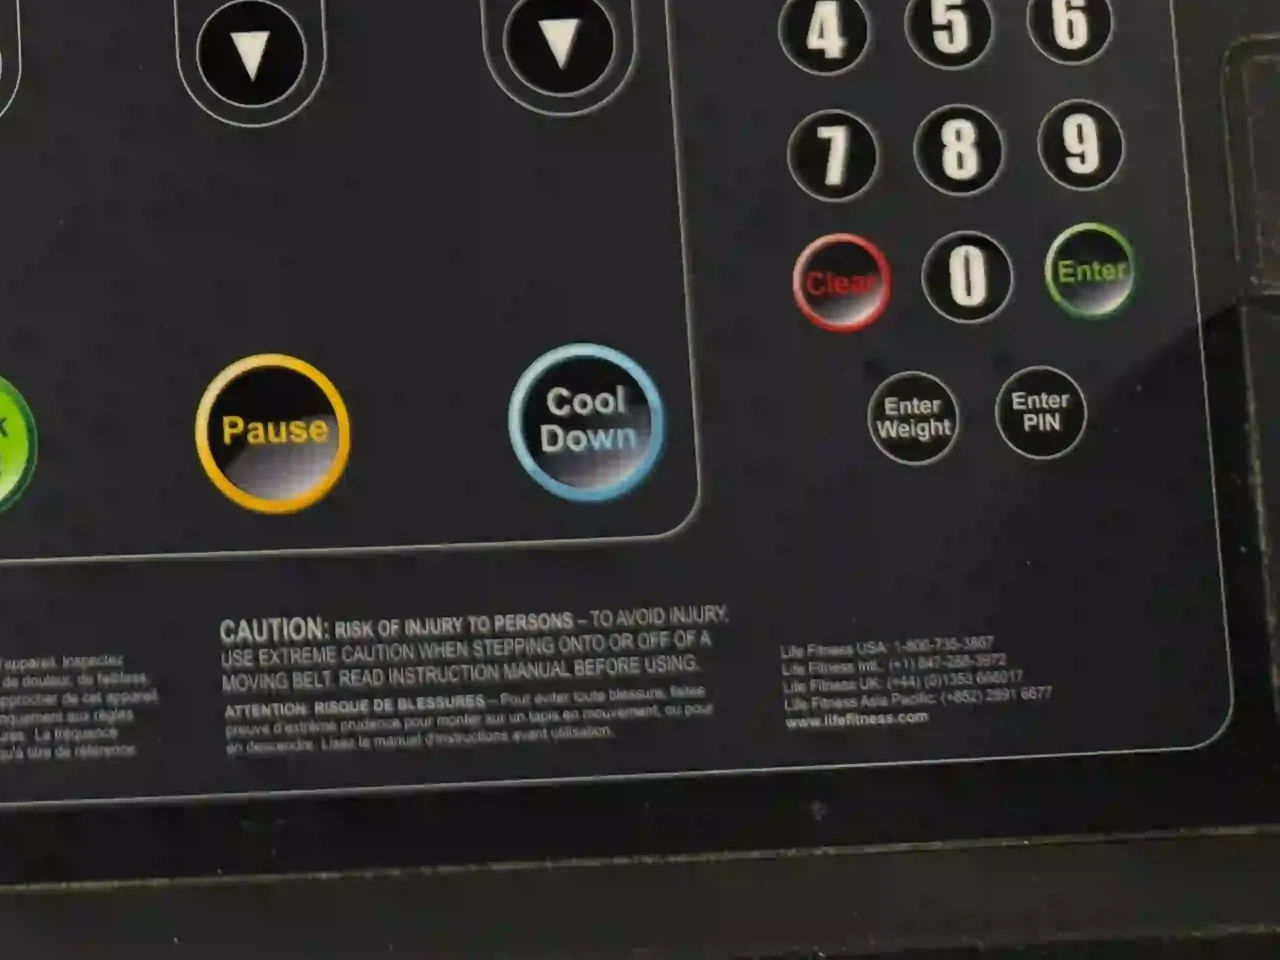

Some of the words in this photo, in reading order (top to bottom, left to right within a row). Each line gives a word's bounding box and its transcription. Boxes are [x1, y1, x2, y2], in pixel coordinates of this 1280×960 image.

[806, 0, 847, 59] 4
[817, 125, 850, 186] 7
[940, 118, 980, 180] 8
[1062, 112, 1101, 175] 9
[807, 271, 874, 297] Clear
[949, 244, 987, 307] 0
[1058, 260, 1126, 283] Enter
[546, 386, 626, 417] Cool
[884, 396, 942, 416] Enter
[1012, 392, 1070, 411] Enter
[223, 416, 329, 446] Pause
[877, 417, 952, 442] Weight
[1024, 412, 1061, 432] PIN
[540, 423, 636, 455] Down
[220, 616, 329, 644] CAUTION:
[335, 620, 374, 639] RISK
[377, 619, 400, 637] OF
[405, 616, 463, 636] INJURY
[467, 615, 490, 632] TO
[494, 612, 574, 632] PERSONS
[590, 610, 613, 628] TO
[615, 607, 665, 627] AVOID
[221, 649, 253, 667] USE
[259, 645, 337, 665] EXTREME
[341, 643, 414, 663] CAUTION
[418, 640, 469, 660] WHEN
[472, 636, 554, 657] STEPPING
[558, 634, 605, 653] ONTO
[609, 632, 633, 651] OR
[637, 630, 669, 649] OFF
[673, 629, 697, 648] OF
[699, 630, 712, 647] A
[222, 672, 288, 692] MOVING
[339, 668, 384, 687] READ
[389, 662, 499, 687] INSTRUCTION
[504, 659, 573, 680] MANUAL
[574, 656, 641, 676] BEFORE
[314, 699, 369, 715] RISQUE
[373, 698, 394, 713] DE
[398, 693, 485, 711] BLESSURES
